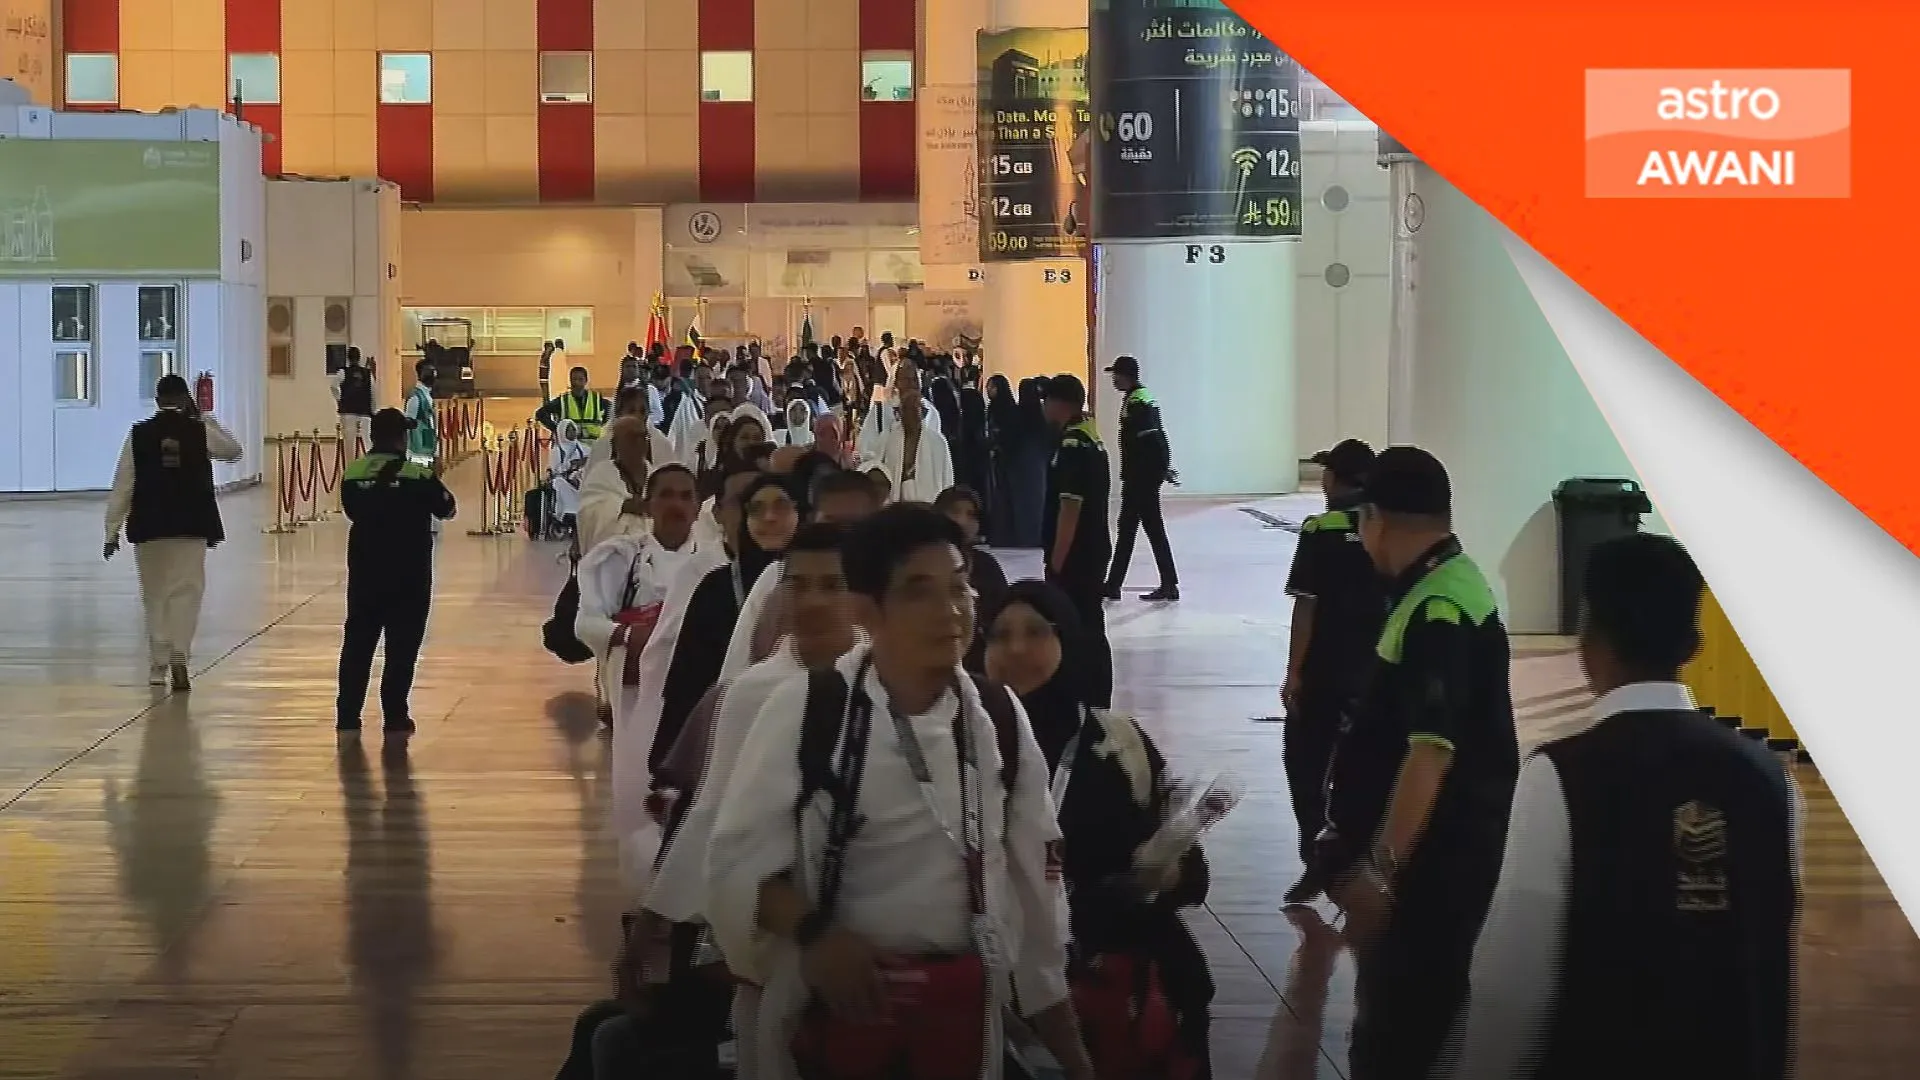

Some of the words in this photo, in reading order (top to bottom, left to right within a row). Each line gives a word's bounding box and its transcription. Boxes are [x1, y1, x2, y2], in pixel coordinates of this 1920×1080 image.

[1184, 46, 1236, 69] شريحة
[1265, 88, 1289, 118] 15
[997, 110, 1030, 123] Data.
[1075, 109, 1091, 122] Ta
[1117, 111, 1153, 142] 60
[998, 126, 1029, 140] Than
[1032, 128, 1041, 140] a
[990, 154, 1011, 175] 15
[1013, 162, 1033, 174] GB
[1265, 149, 1290, 177] 12
[991, 196, 1010, 217] 12
[1013, 204, 1032, 216] GB
[1184, 245, 1204, 264] F
[1043, 268, 1057, 283] E
